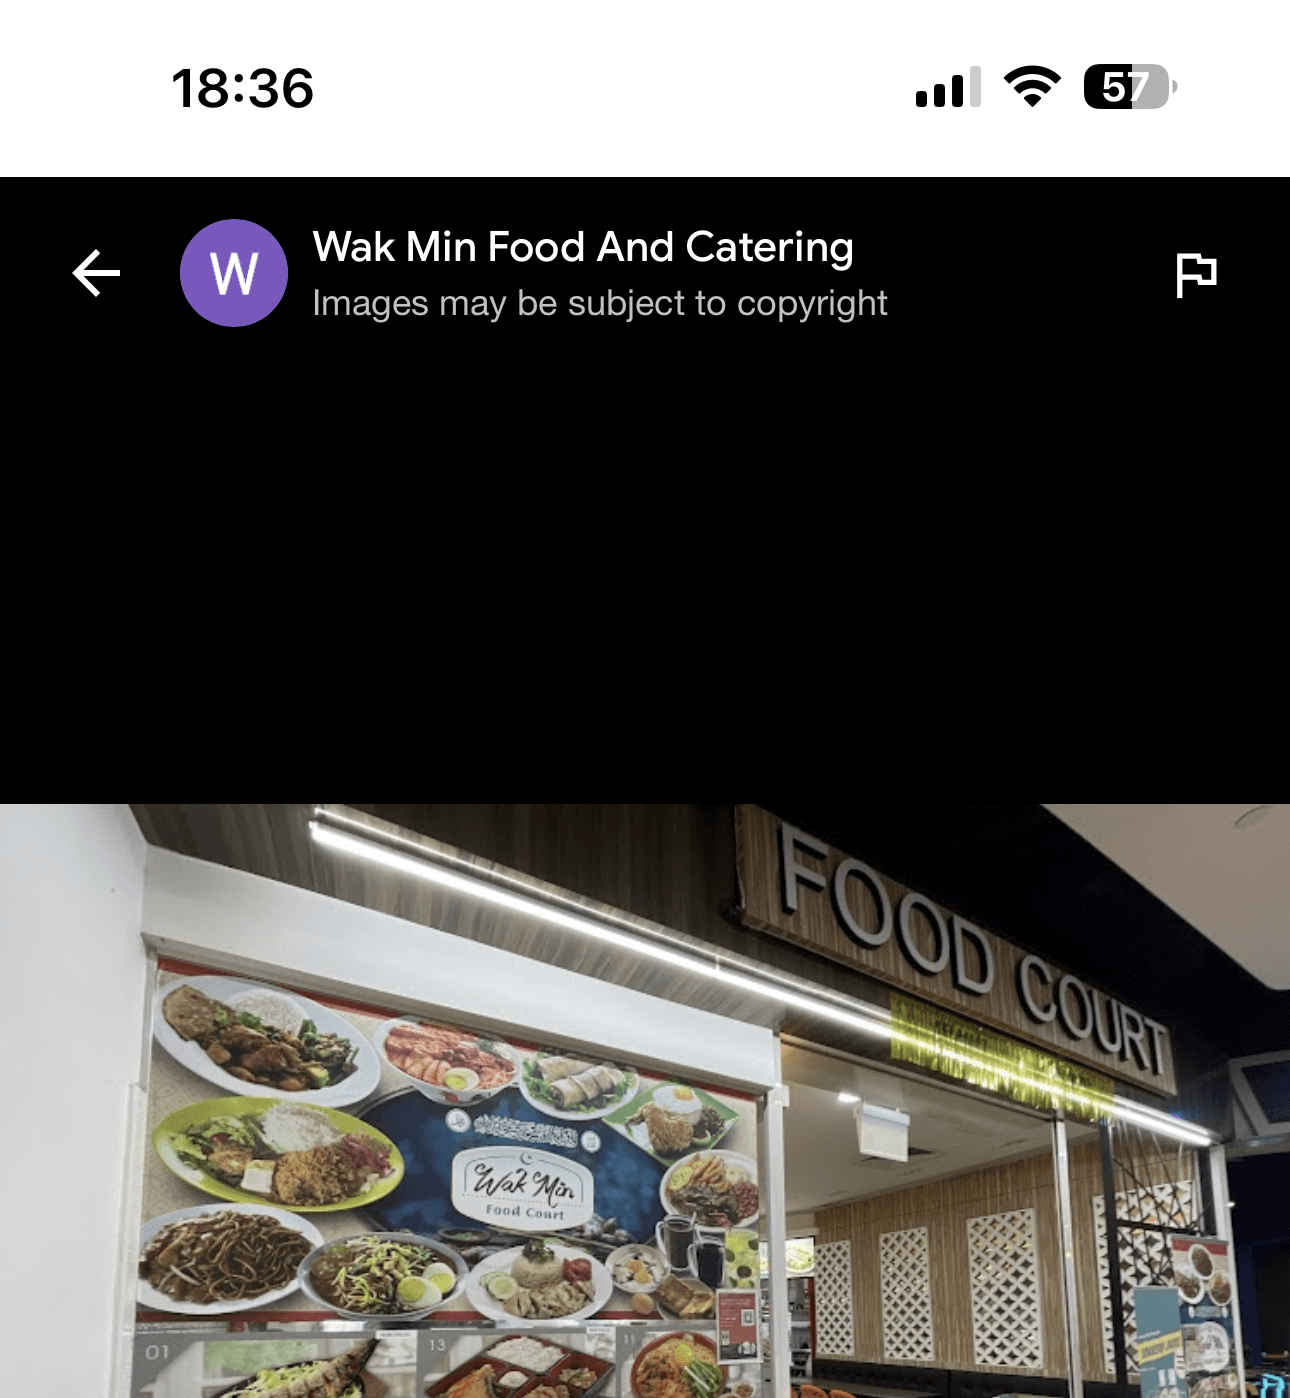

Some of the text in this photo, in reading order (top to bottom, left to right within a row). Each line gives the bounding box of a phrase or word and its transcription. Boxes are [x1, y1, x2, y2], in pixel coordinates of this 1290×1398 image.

[777, 822, 1170, 1075] FOOD COURT
[473, 1162, 575, 1209] Wak Min
[485, 1203, 565, 1221] Food Court
[145, 1344, 170, 1361] 01
[428, 1338, 446, 1352] 13
